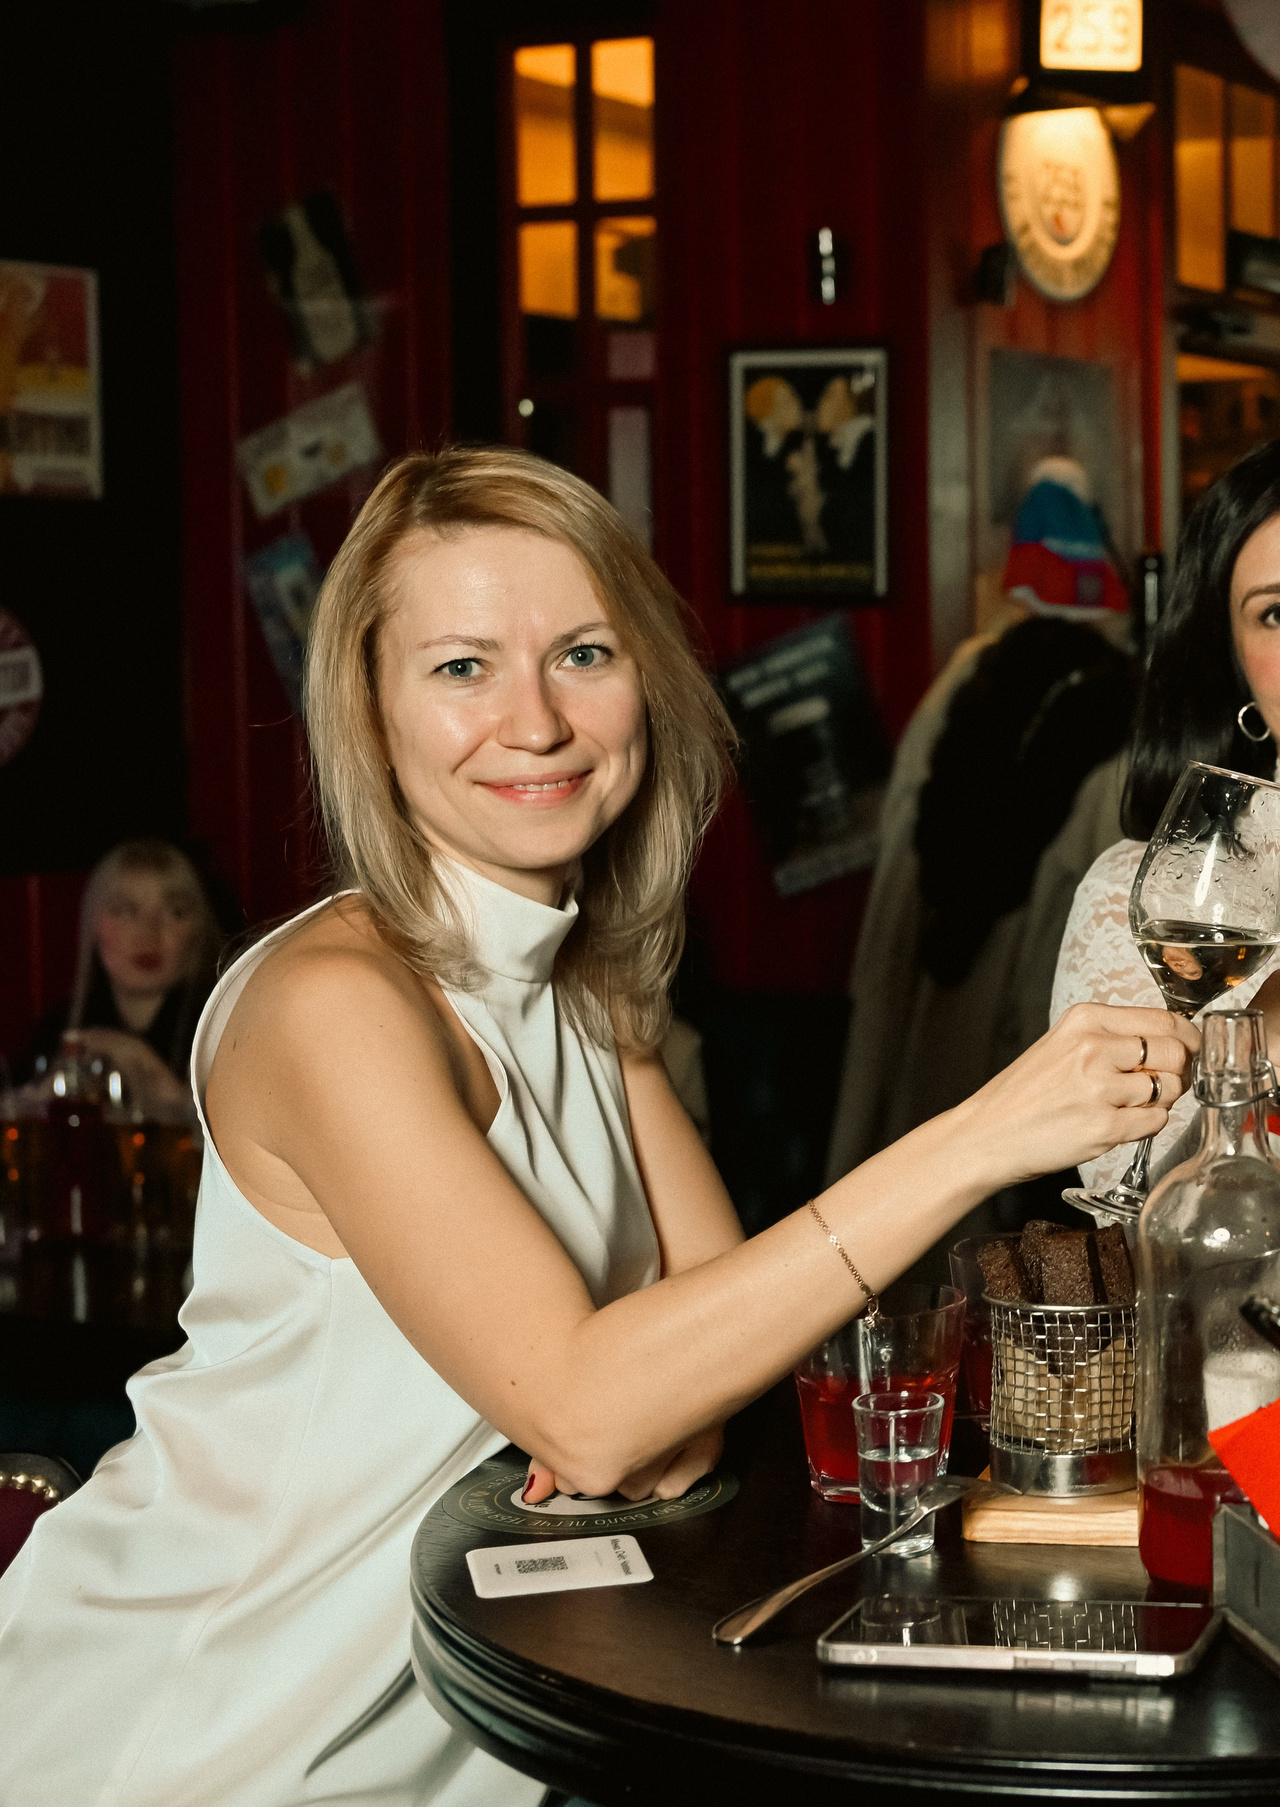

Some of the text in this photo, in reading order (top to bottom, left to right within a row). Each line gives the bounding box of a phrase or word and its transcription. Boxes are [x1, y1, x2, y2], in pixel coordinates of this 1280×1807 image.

[652, 1503, 685, 1517] ЕМУ
[487, 1514, 527, 1525] ТЕБЯ
[531, 1519, 588, 1527] ЛЕГЧЕ
